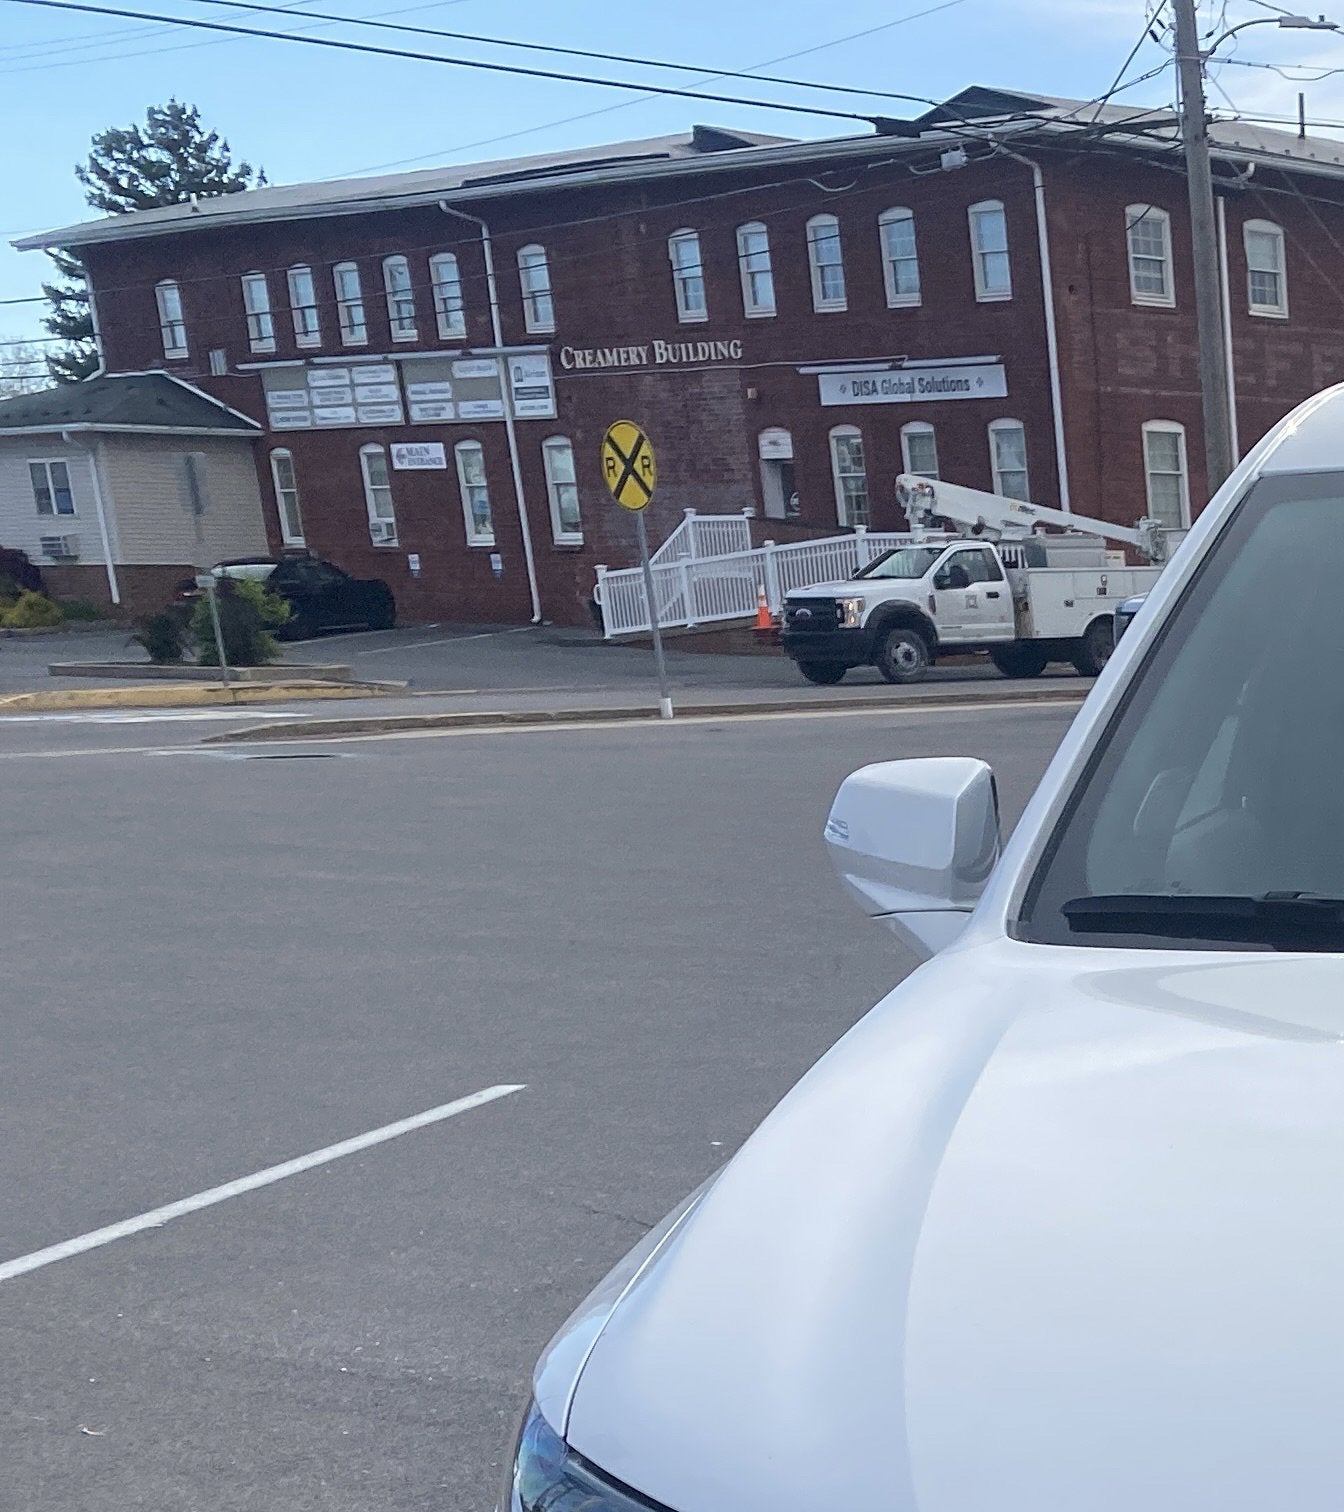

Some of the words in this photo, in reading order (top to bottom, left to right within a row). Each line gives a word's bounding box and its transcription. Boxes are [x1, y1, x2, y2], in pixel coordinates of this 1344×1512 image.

[652, 339, 743, 364] BUILDING
[851, 380, 878, 397] DISA
[881, 376, 915, 396] Global
[918, 375, 970, 394] Solutions
[606, 456, 618, 478] R
[641, 455, 653, 477] R
